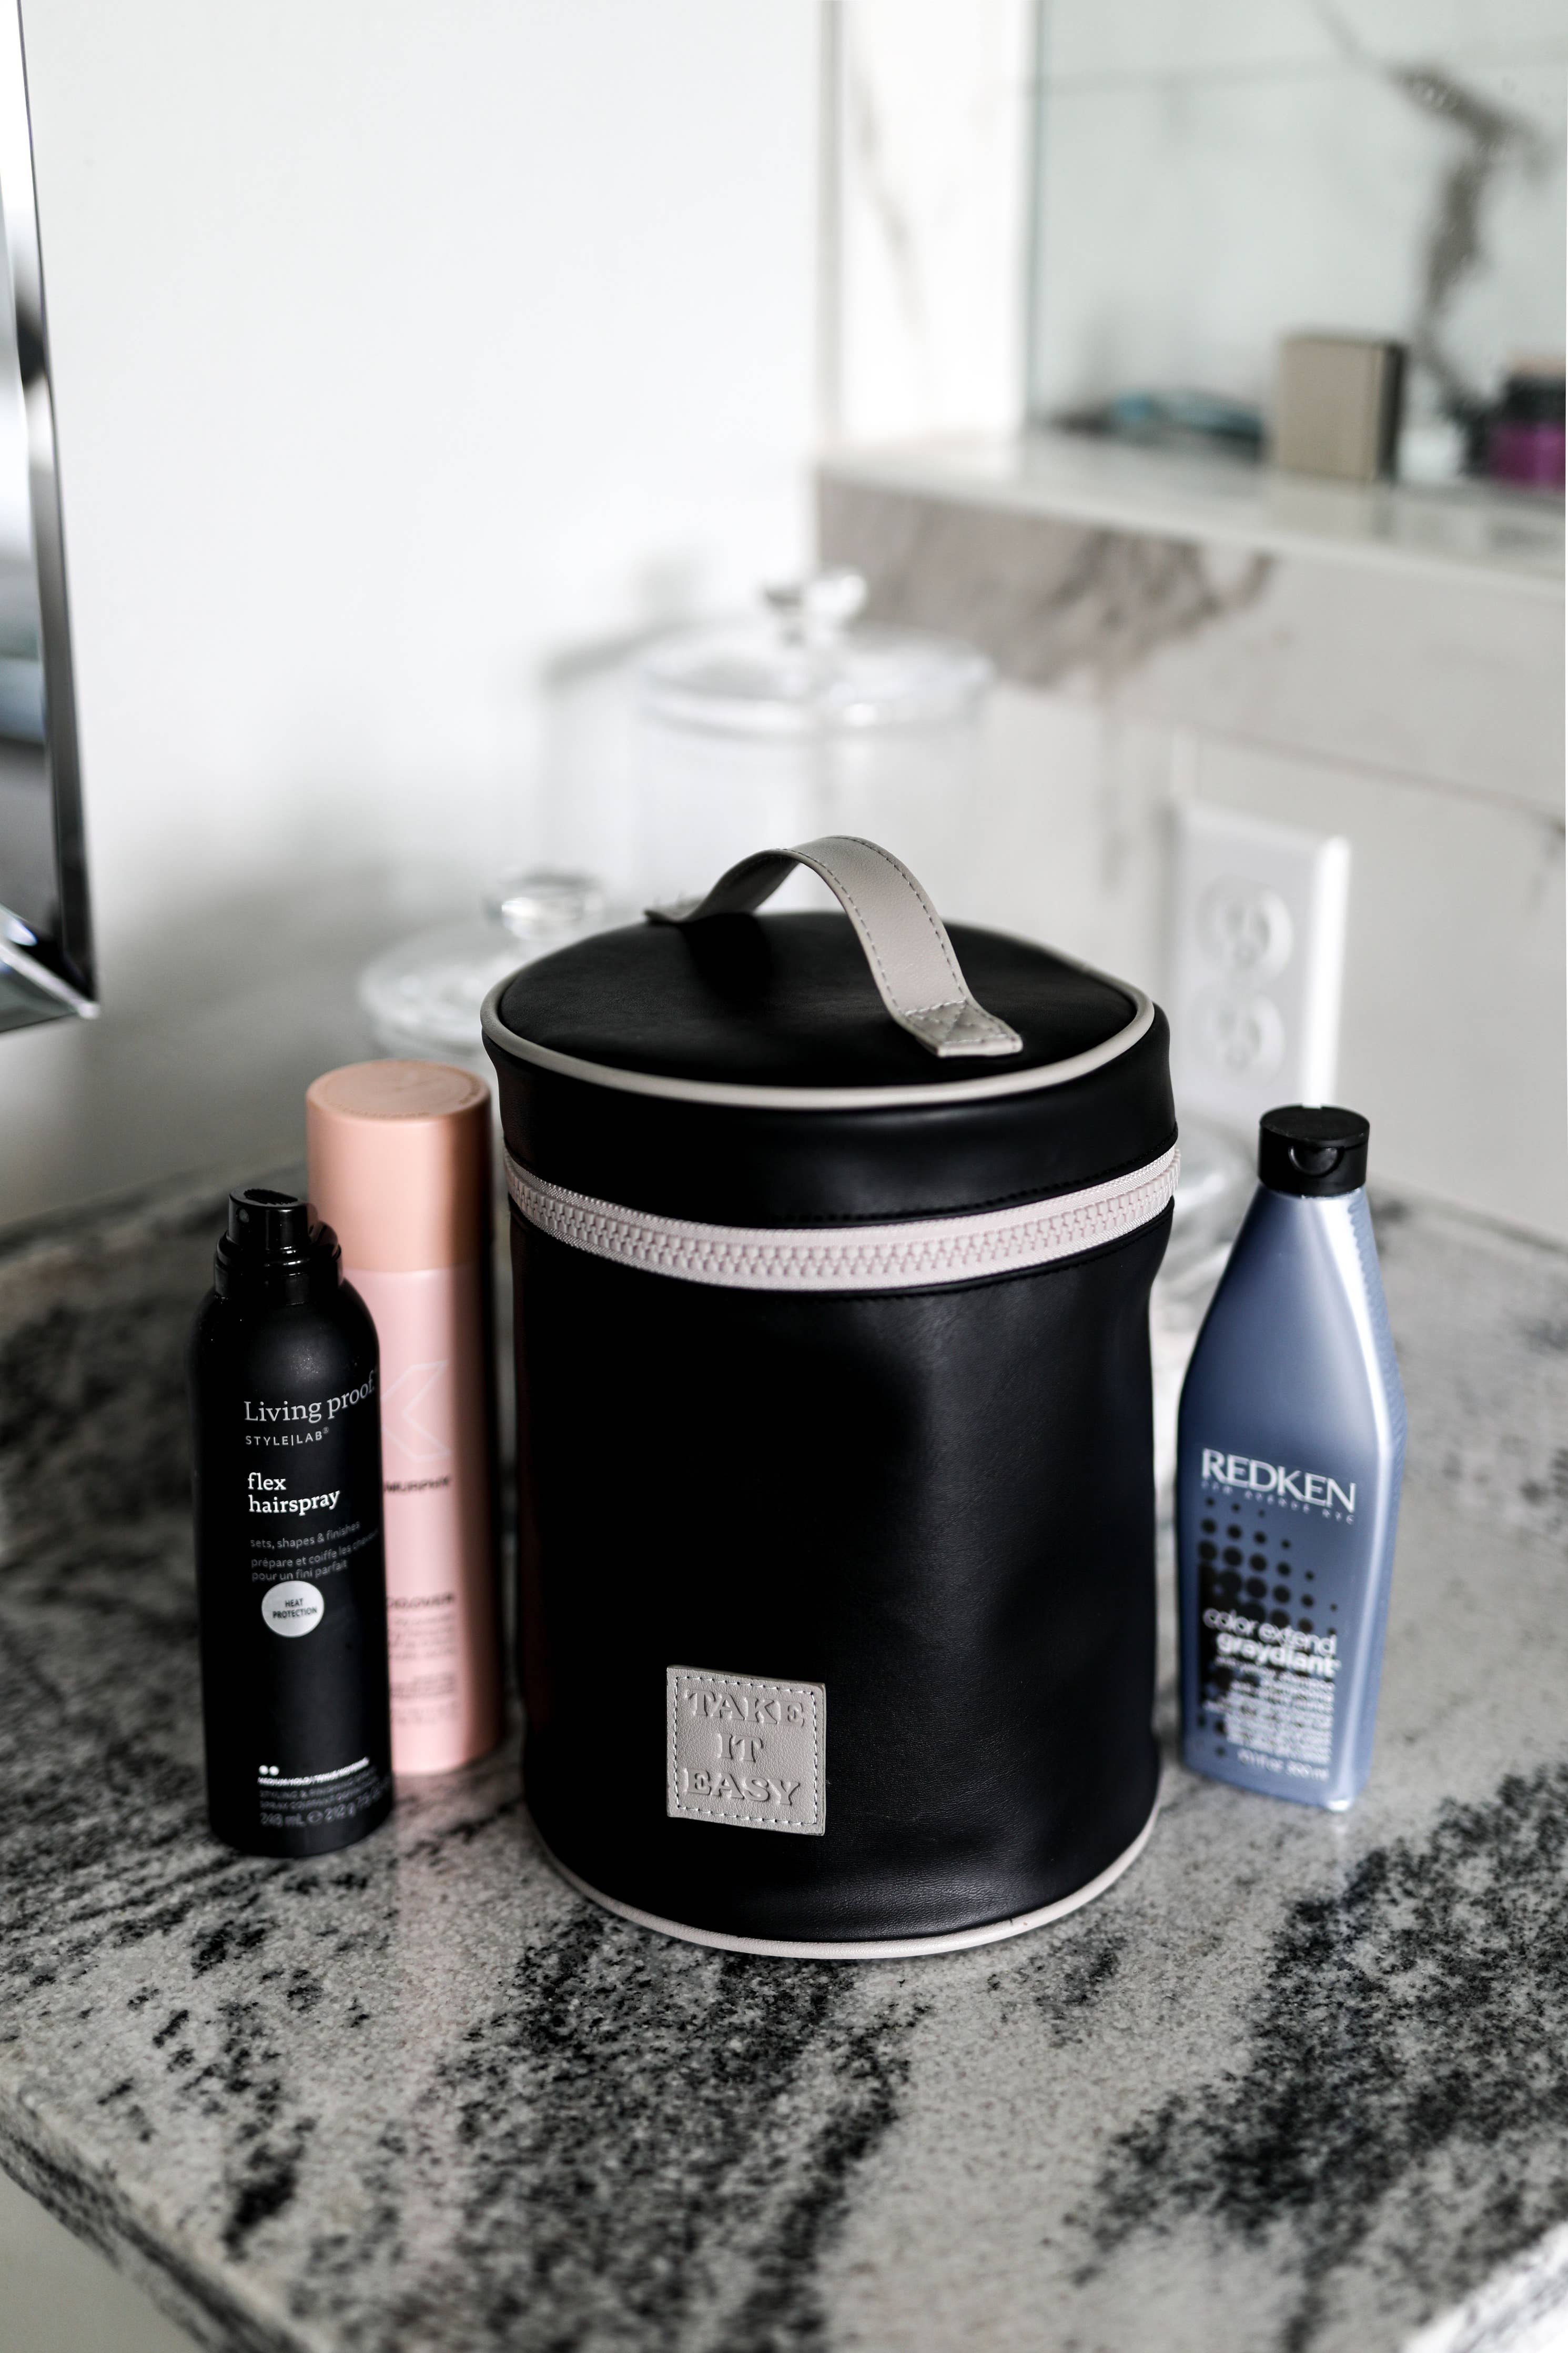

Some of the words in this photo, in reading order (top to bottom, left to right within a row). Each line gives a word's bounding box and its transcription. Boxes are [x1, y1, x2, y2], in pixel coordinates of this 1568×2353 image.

[244, 1401, 321, 1423] Living
[248, 1472, 287, 1491] flex
[1201, 1448, 1356, 1513] REDKEN
[248, 1490, 340, 1516] hairspray
[250, 1539, 275, 1549] sets,
[277, 1537, 315, 1549] shapes
[317, 1533, 325, 1543] &
[326, 1521, 360, 1541] finishes
[296, 1556, 306, 1566] et
[308, 1549, 337, 1564] coiffe
[338, 1544, 351, 1555] les
[252, 1571, 277, 1582] pour
[279, 1571, 294, 1580] un
[296, 1567, 313, 1579] fini
[315, 1559, 348, 1578] parfait
[272, 1606, 318, 1619] PROTECTION
[285, 1598, 304, 1608] HEAT
[1203, 1608, 1259, 1636] color
[1259, 1622, 1337, 1656] extend
[684, 1688, 805, 1727] TAKE
[716, 1733, 764, 1763] IT
[683, 1768, 801, 1806] EASY
